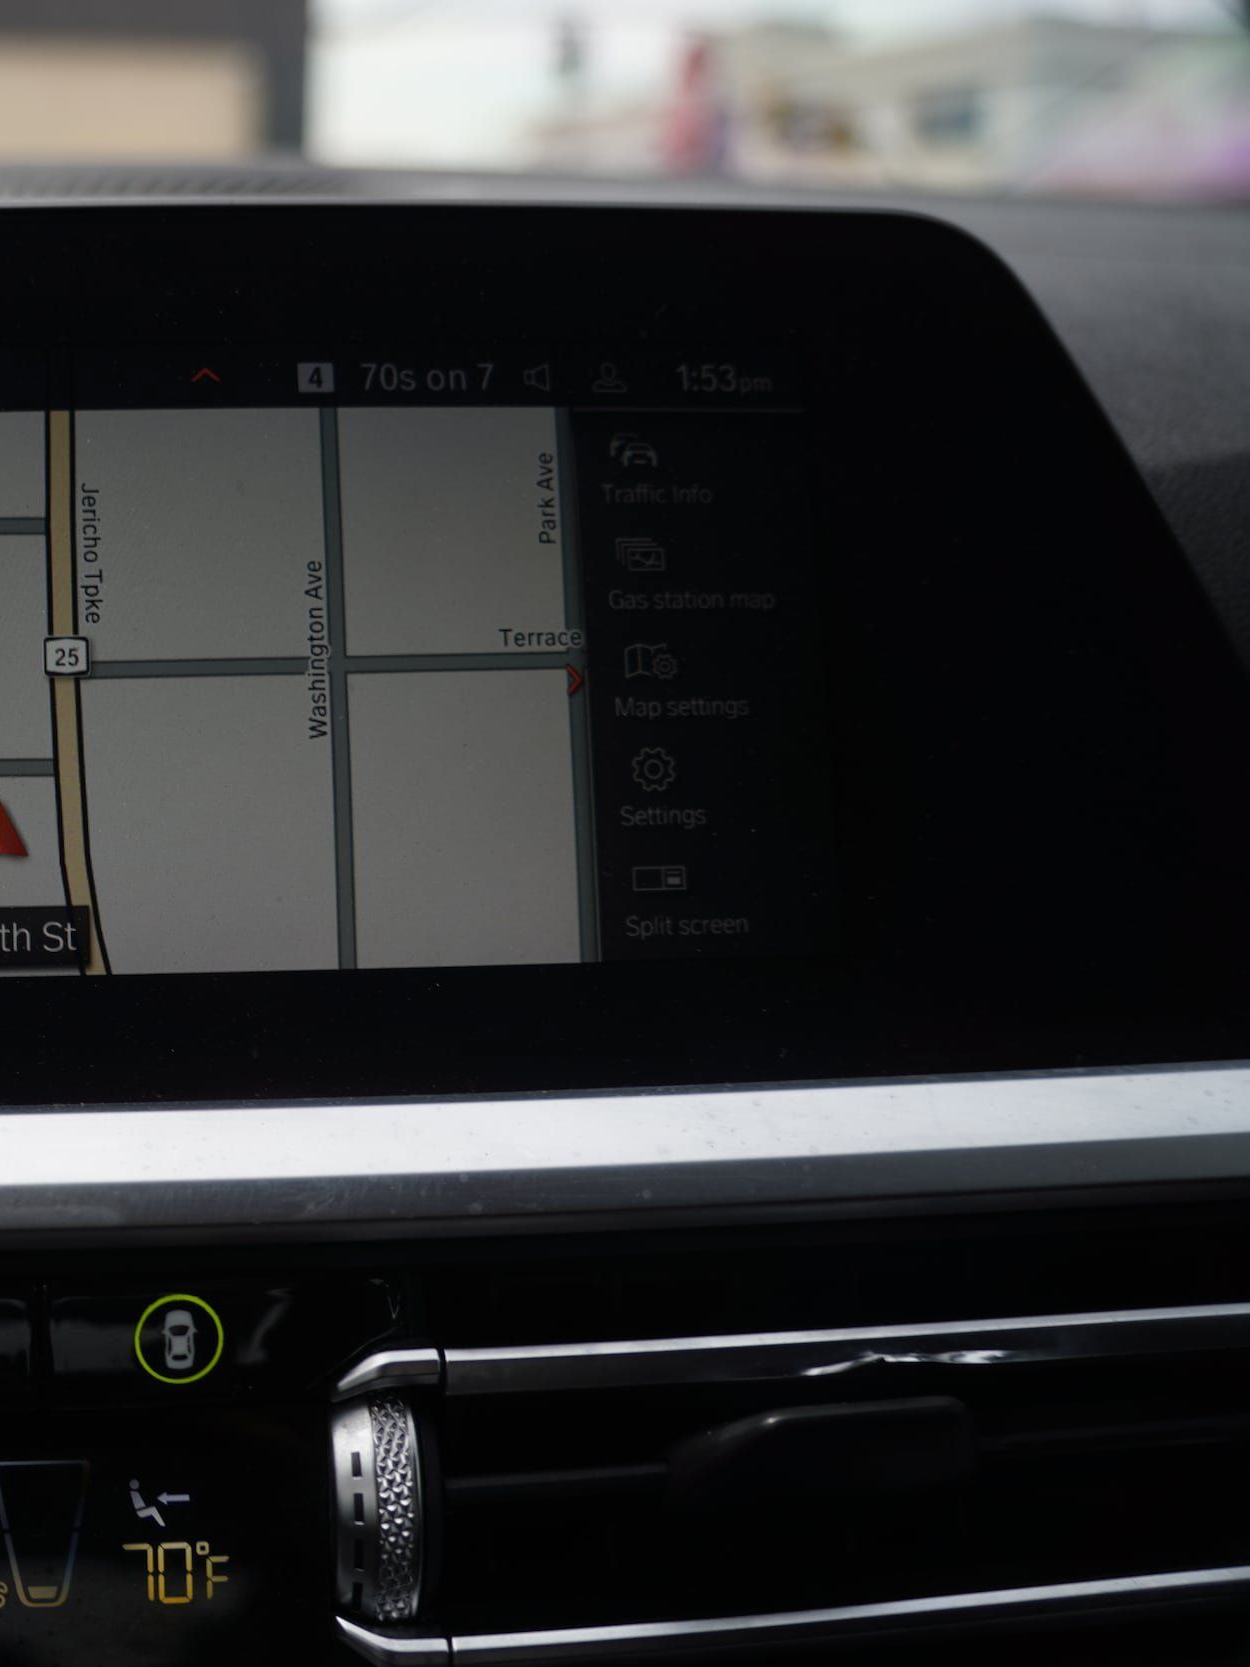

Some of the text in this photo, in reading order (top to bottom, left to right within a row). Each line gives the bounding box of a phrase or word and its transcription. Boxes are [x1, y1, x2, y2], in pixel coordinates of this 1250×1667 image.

[309, 366, 323, 388] 4
[360, 363, 494, 392] 70s on 7
[537, 452, 556, 543] Park Ave
[602, 483, 667, 504] Traffic
[81, 483, 103, 624] Jericho Tpke
[608, 589, 776, 612] Gas station map
[305, 560, 329, 739] Washington Ave
[498, 628, 583, 648] Terrace
[54, 648, 80, 667] 25
[614, 696, 750, 720] Map settings
[620, 805, 707, 830] Settings
[42, 921, 78, 952] St
[625, 915, 750, 940] Split screen
